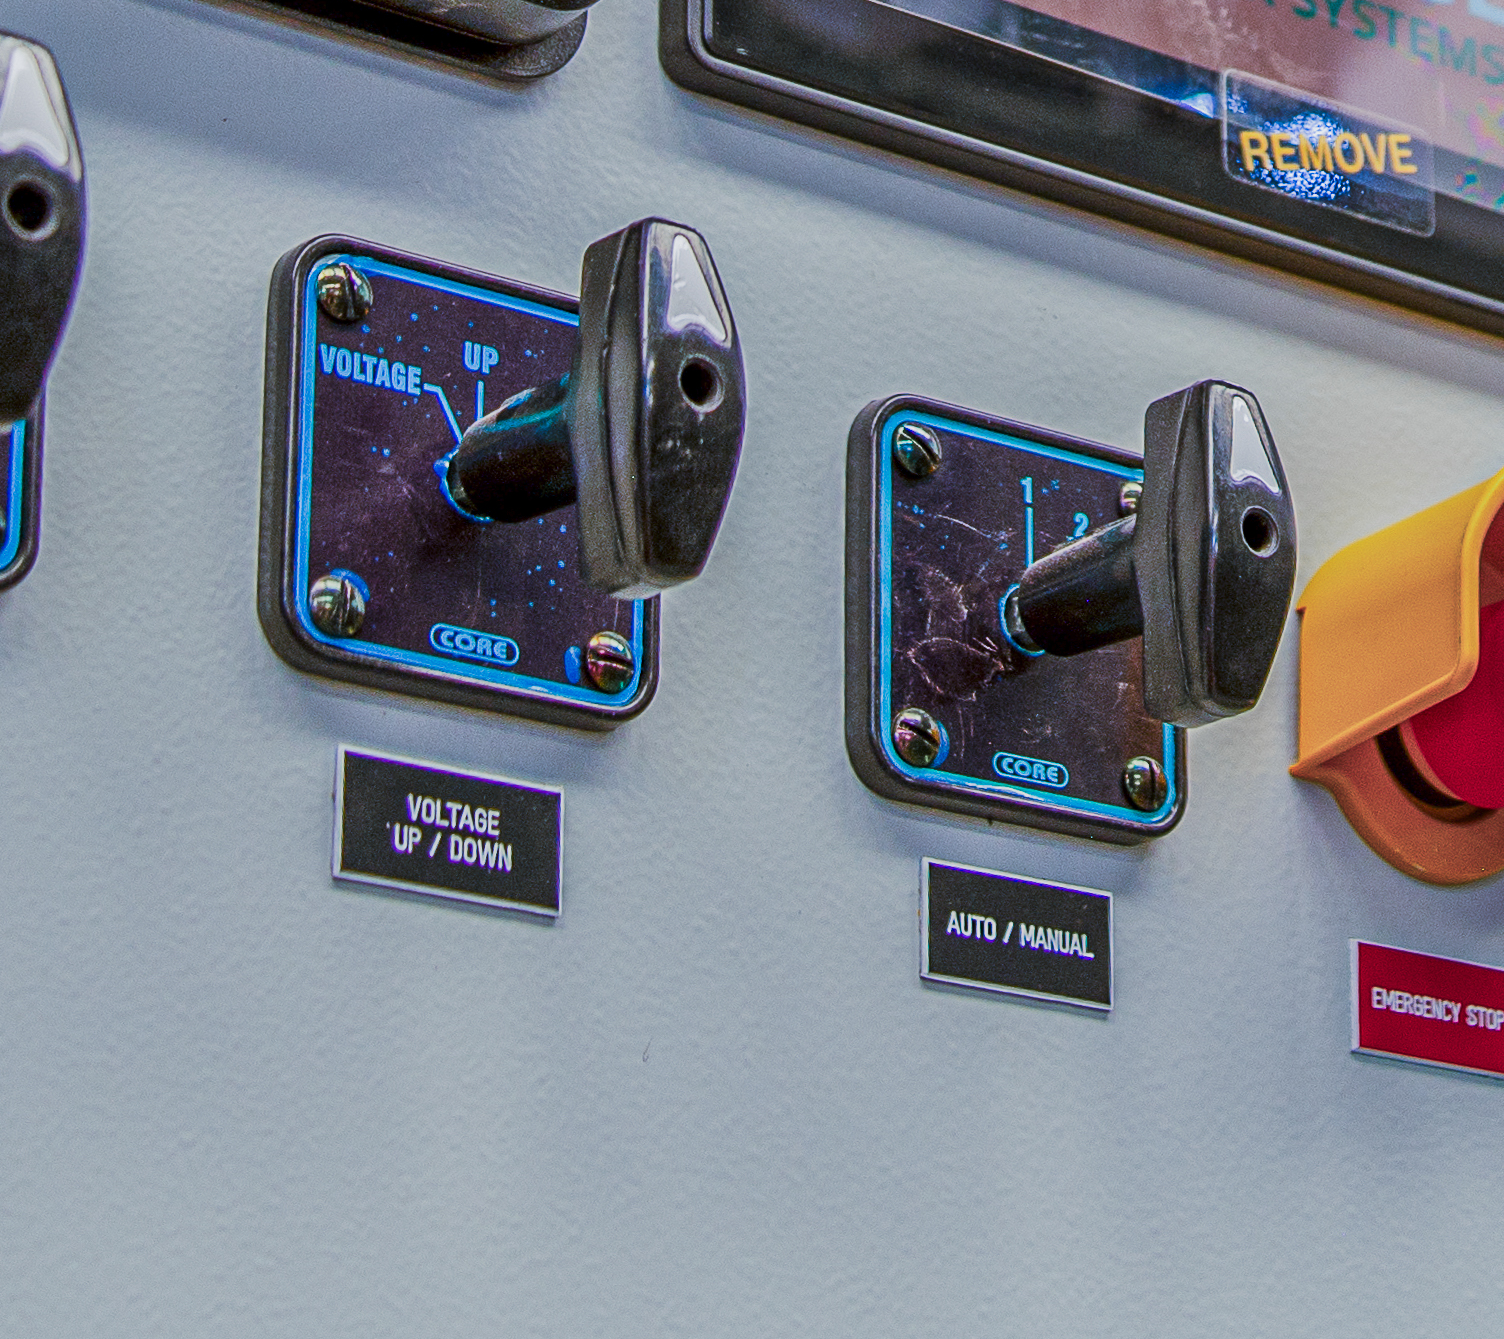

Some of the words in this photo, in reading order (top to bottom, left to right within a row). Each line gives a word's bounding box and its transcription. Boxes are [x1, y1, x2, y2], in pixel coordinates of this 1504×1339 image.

[1239, 129, 1418, 175] REMOVE
[318, 344, 422, 396] VOLTAGE
[461, 339, 500, 376] UP
[1019, 476, 1033, 505] 1
[1072, 512, 1090, 538] 2
[438, 629, 510, 661] CORE
[1000, 756, 1060, 783] CORE
[405, 792, 501, 838] VOLTAGE
[392, 822, 423, 855] UP
[428, 830, 443, 859] /
[448, 833, 513, 874] DOWN
[946, 910, 997, 943] AUTO
[1002, 921, 1015, 946] /
[1018, 922, 1095, 962] MANUAL
[1370, 985, 1462, 1024] EMERGENCY
